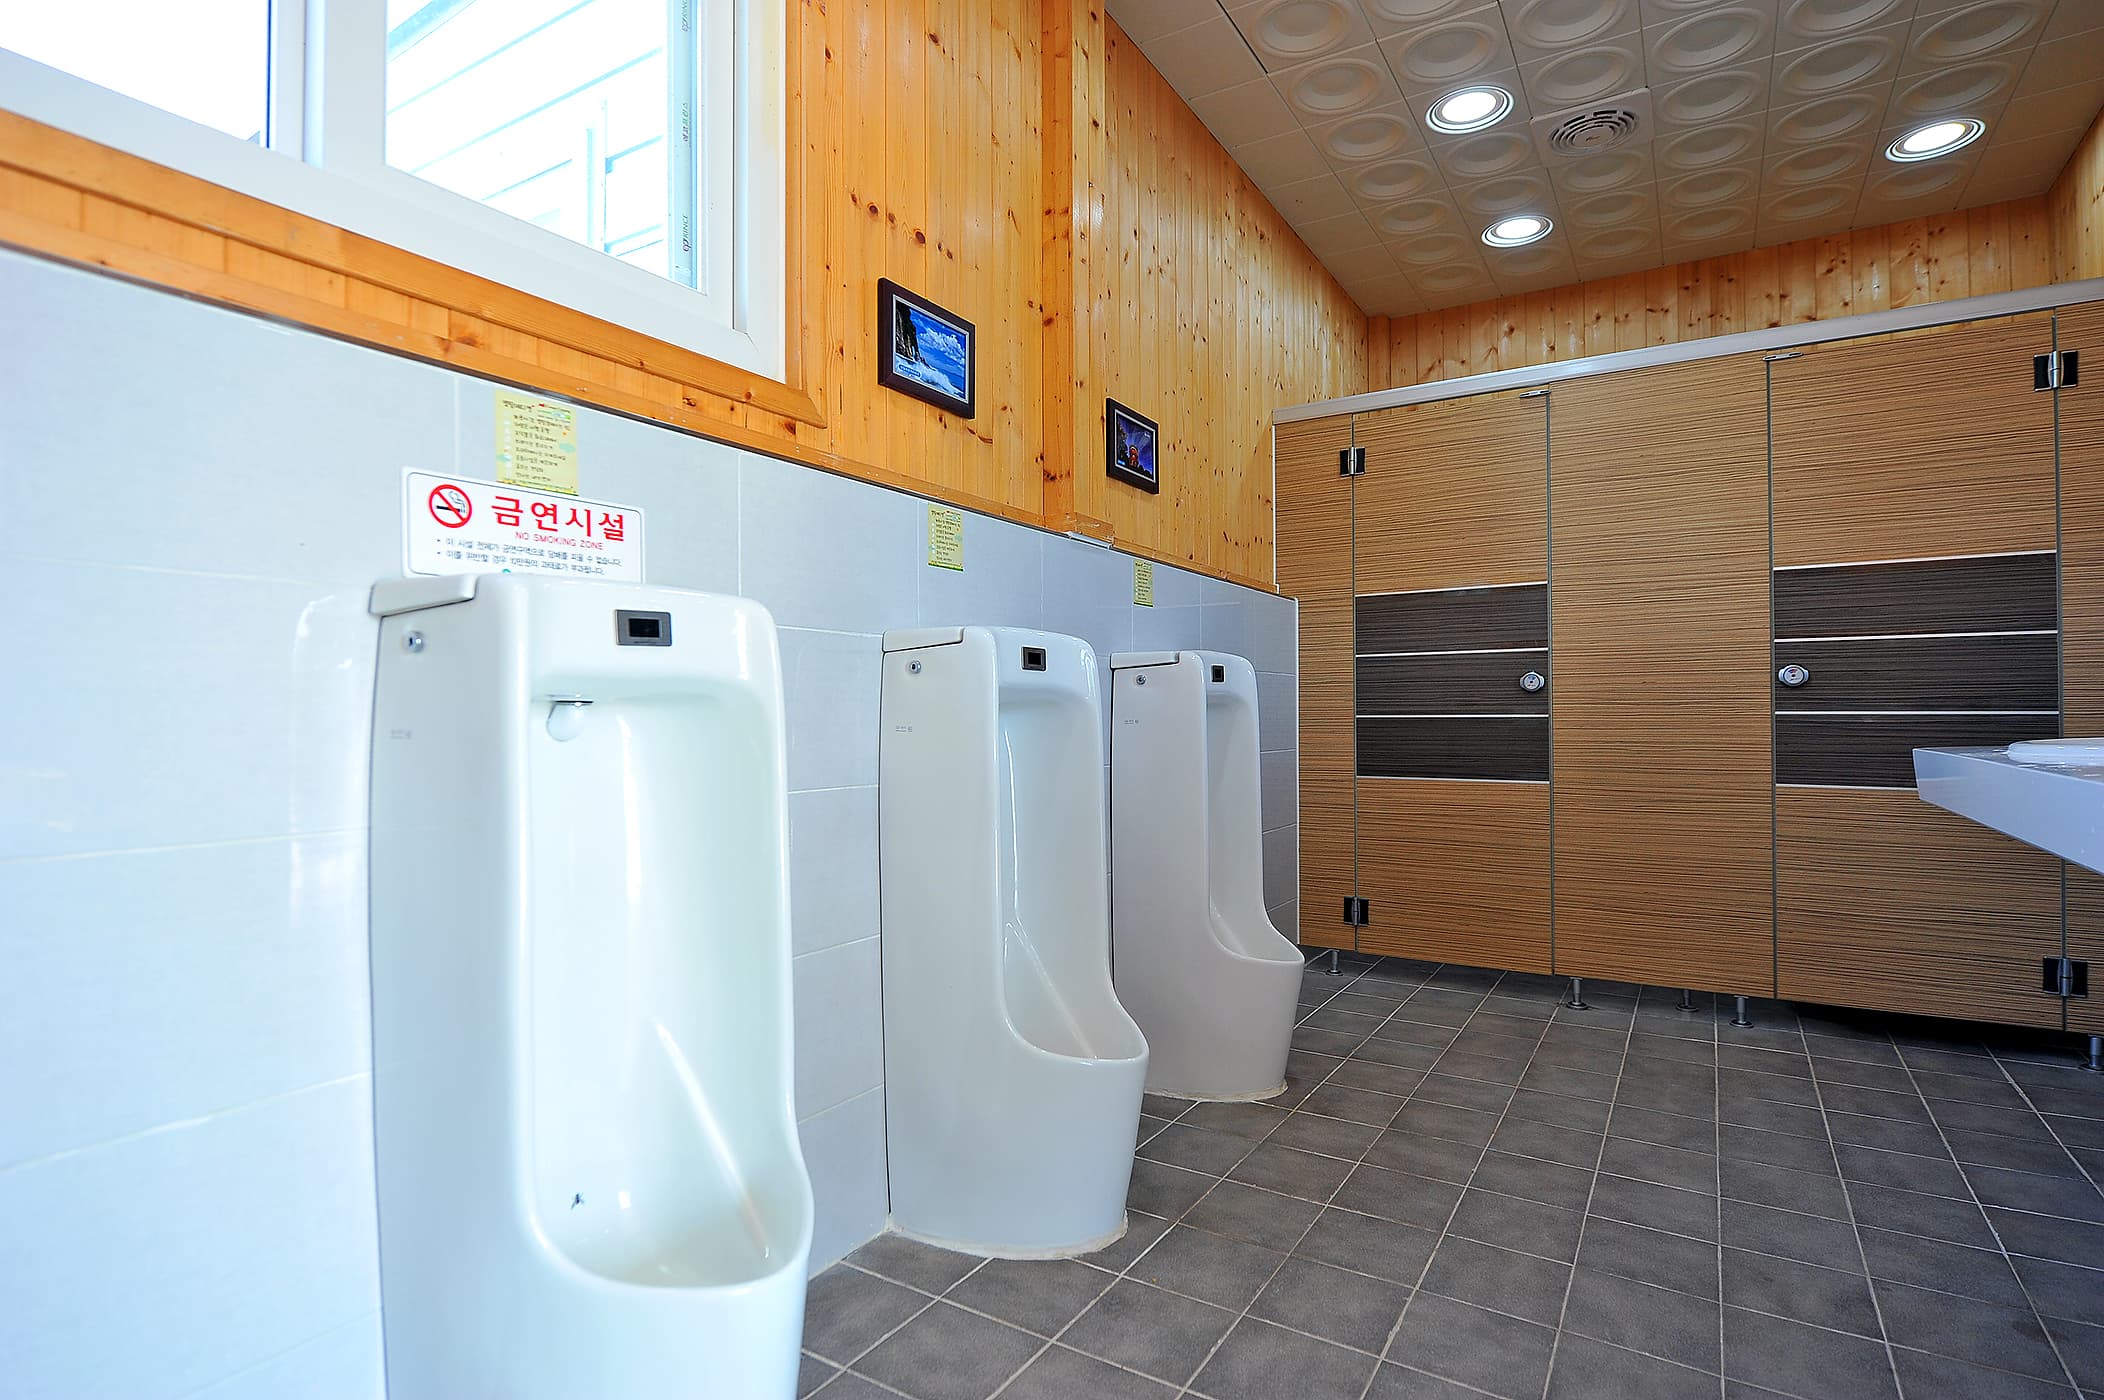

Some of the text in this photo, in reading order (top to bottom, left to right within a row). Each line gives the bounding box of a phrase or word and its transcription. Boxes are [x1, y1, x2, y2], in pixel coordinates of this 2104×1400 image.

[490, 495, 625, 541] 금연시설
[515, 531, 604, 551] NO SMOKING ZONE
